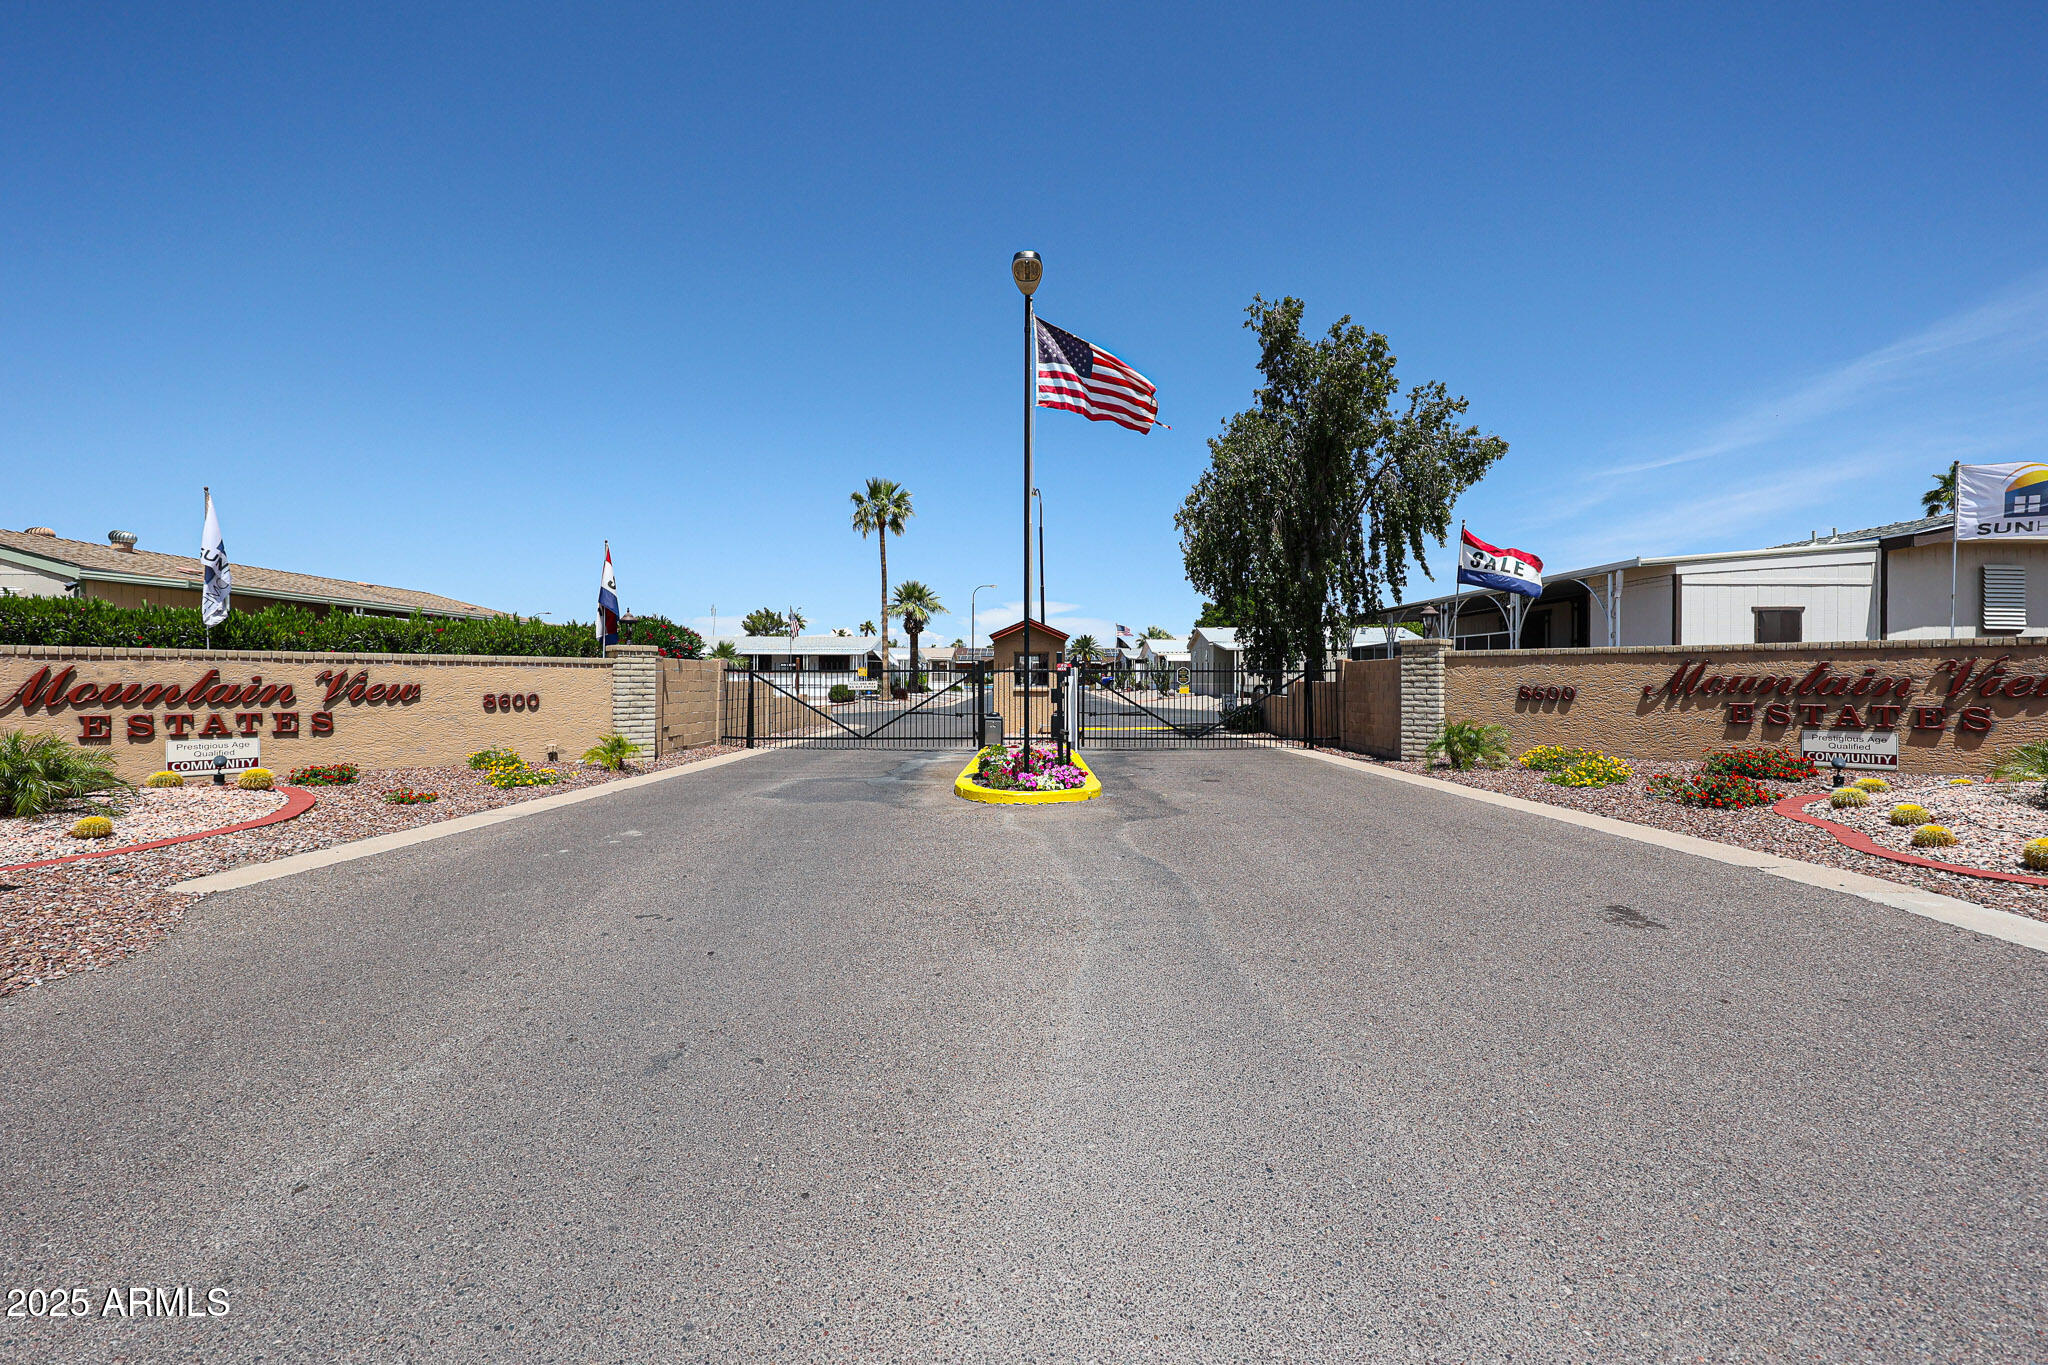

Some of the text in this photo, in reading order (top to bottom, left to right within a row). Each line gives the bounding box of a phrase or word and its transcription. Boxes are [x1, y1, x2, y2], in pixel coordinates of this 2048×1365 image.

[1470, 551, 1525, 577] SALE
[0, 664, 421, 708] Mountain View
[1643, 659, 1917, 698] Mountain
[483, 691, 540, 708] 8600
[1519, 685, 1577, 701] 8600
[78, 711, 334, 738] ESTATES
[1728, 702, 1993, 731] ESTATES
[176, 741, 250, 751] Prestigious Age
[1811, 733, 1887, 744] Prestigious Age
[1828, 742, 1871, 750] Qualified
[193, 749, 235, 757] Qualified
[1807, 751, 1892, 765] COMMUNITY
[171, 758, 255, 772] COMMNITY
